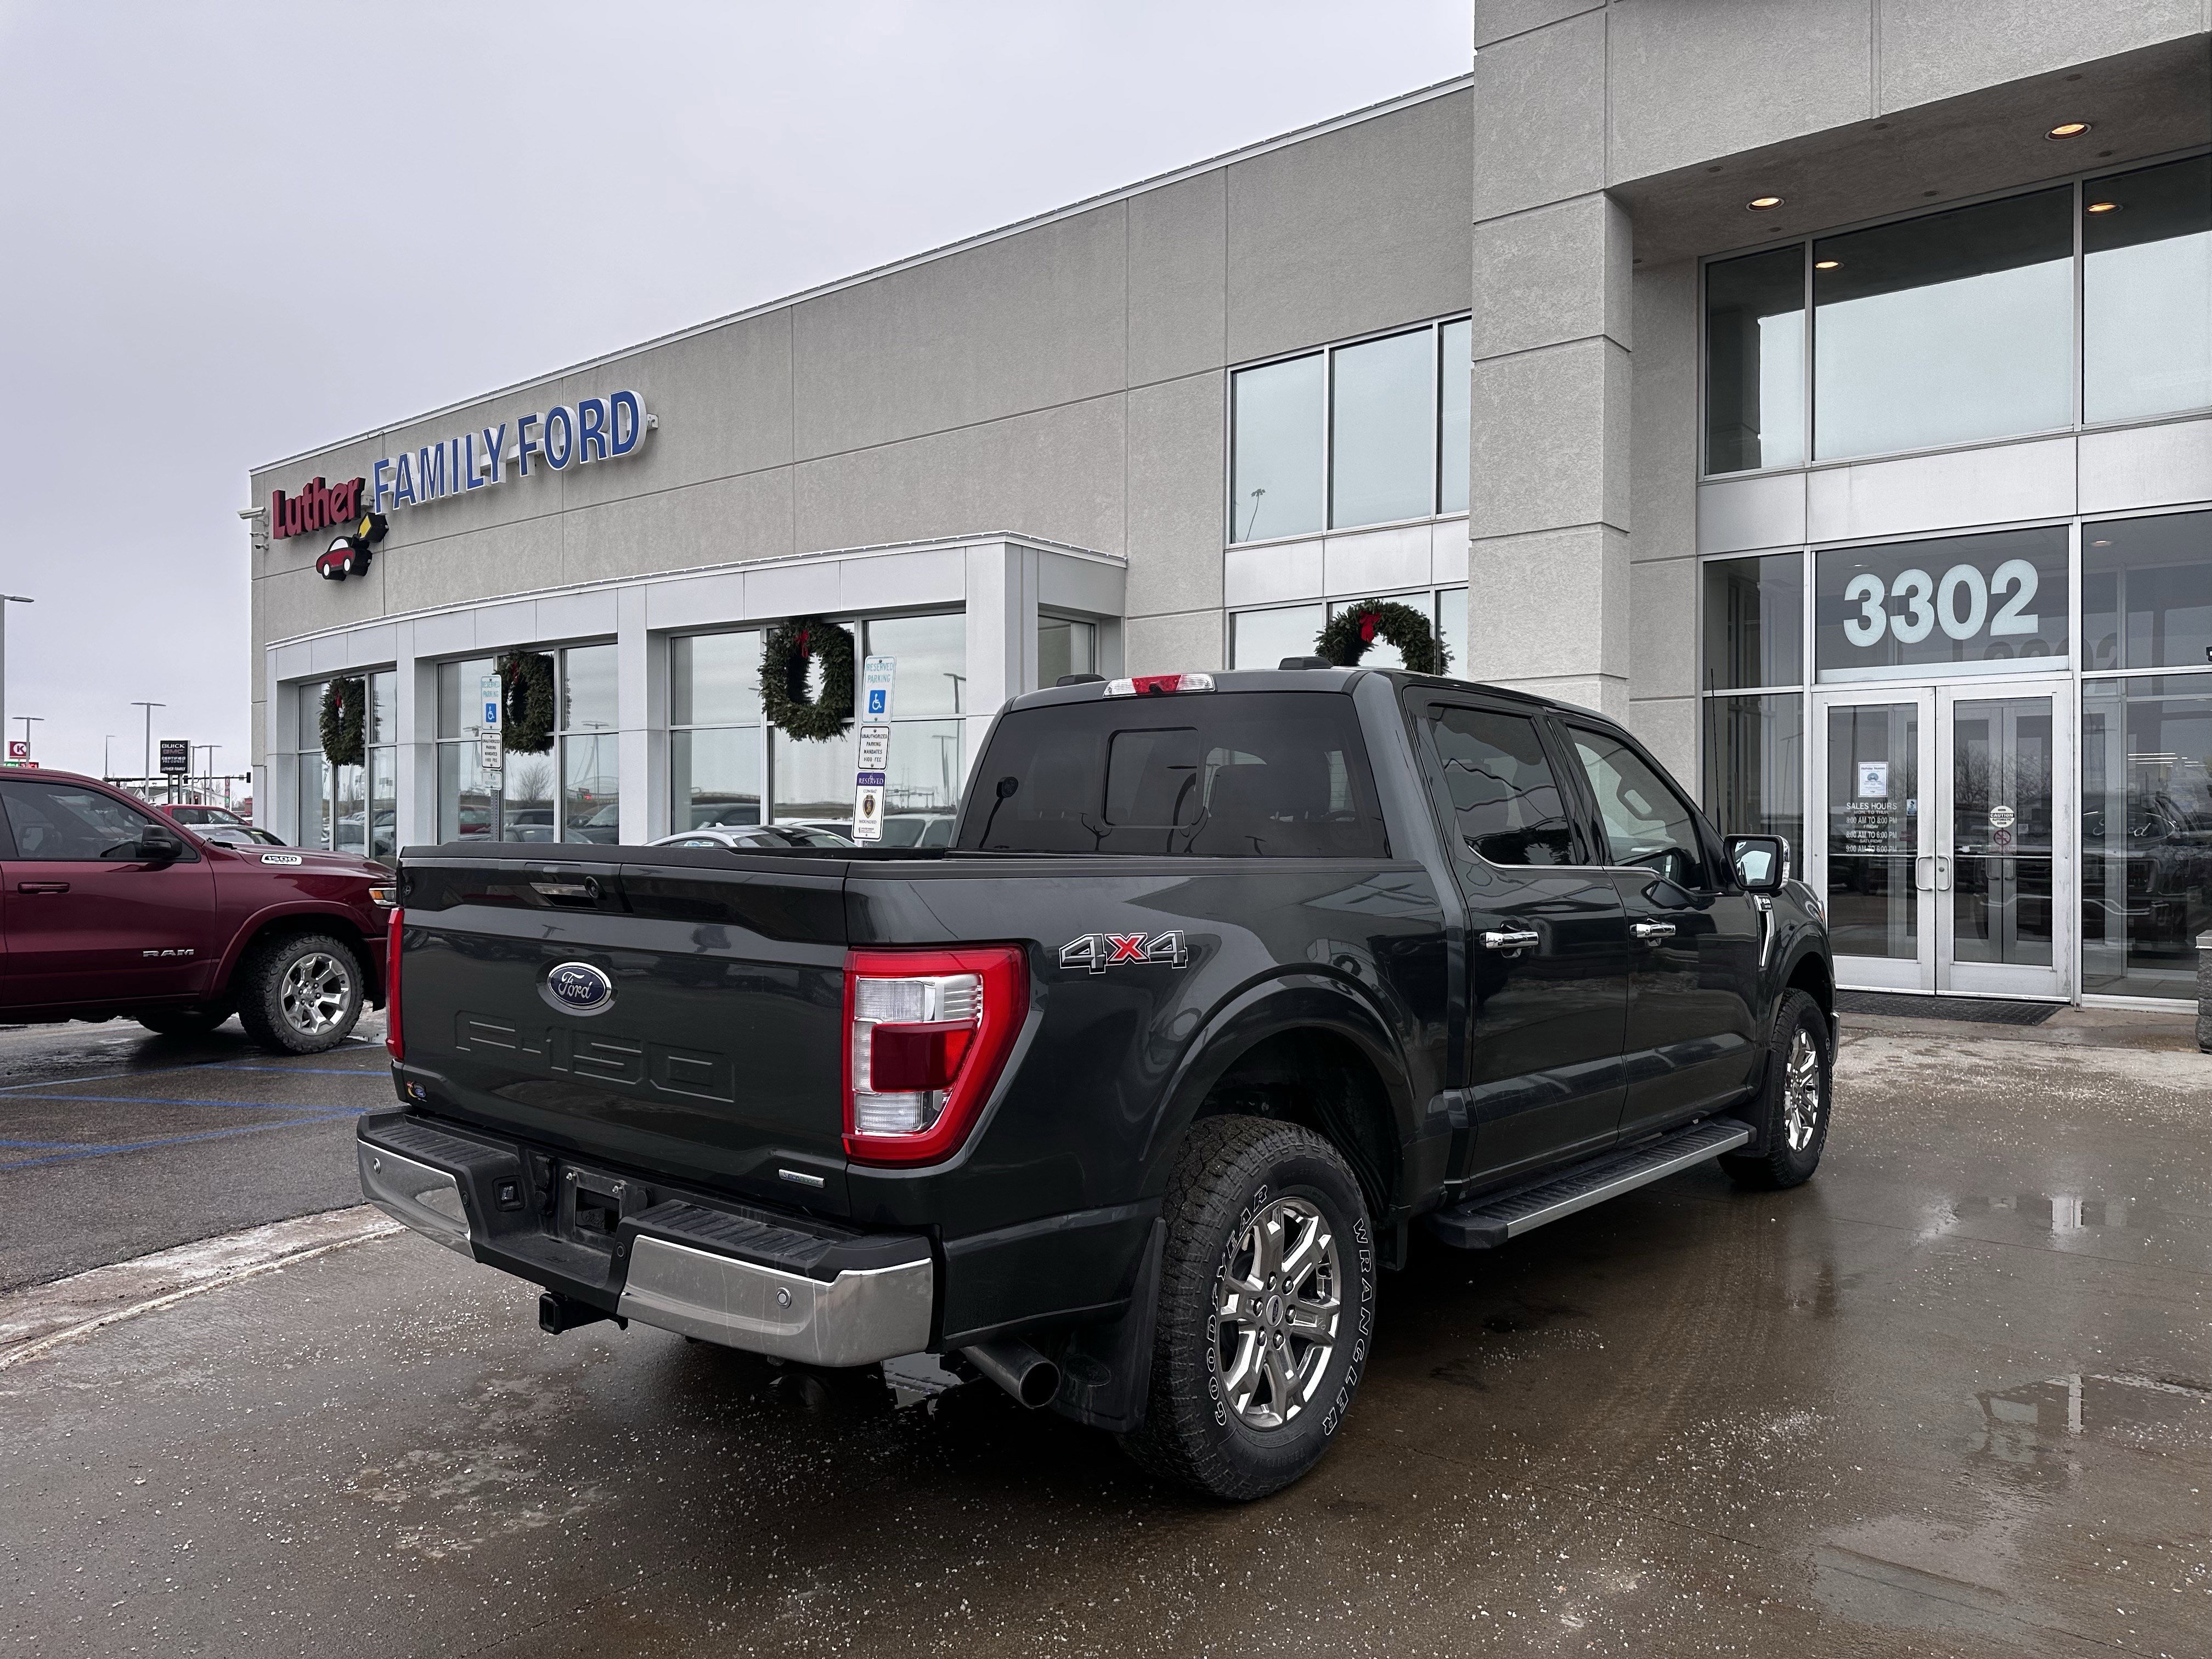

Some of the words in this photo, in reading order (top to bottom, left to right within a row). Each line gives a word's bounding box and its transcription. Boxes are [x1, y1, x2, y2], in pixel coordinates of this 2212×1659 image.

[272, 477, 365, 540] Luther
[374, 422, 508, 515] FAMILY
[517, 389, 645, 477] FORD
[1843, 558, 2039, 647] 3302
[866, 662, 894, 672] RESERVED
[867, 674, 890, 683] PARKING
[558, 971, 593, 999] Ford
[1207, 1184, 1267, 1426] GOODYEAR
[1322, 1218, 1372, 1436] WRANGLER
